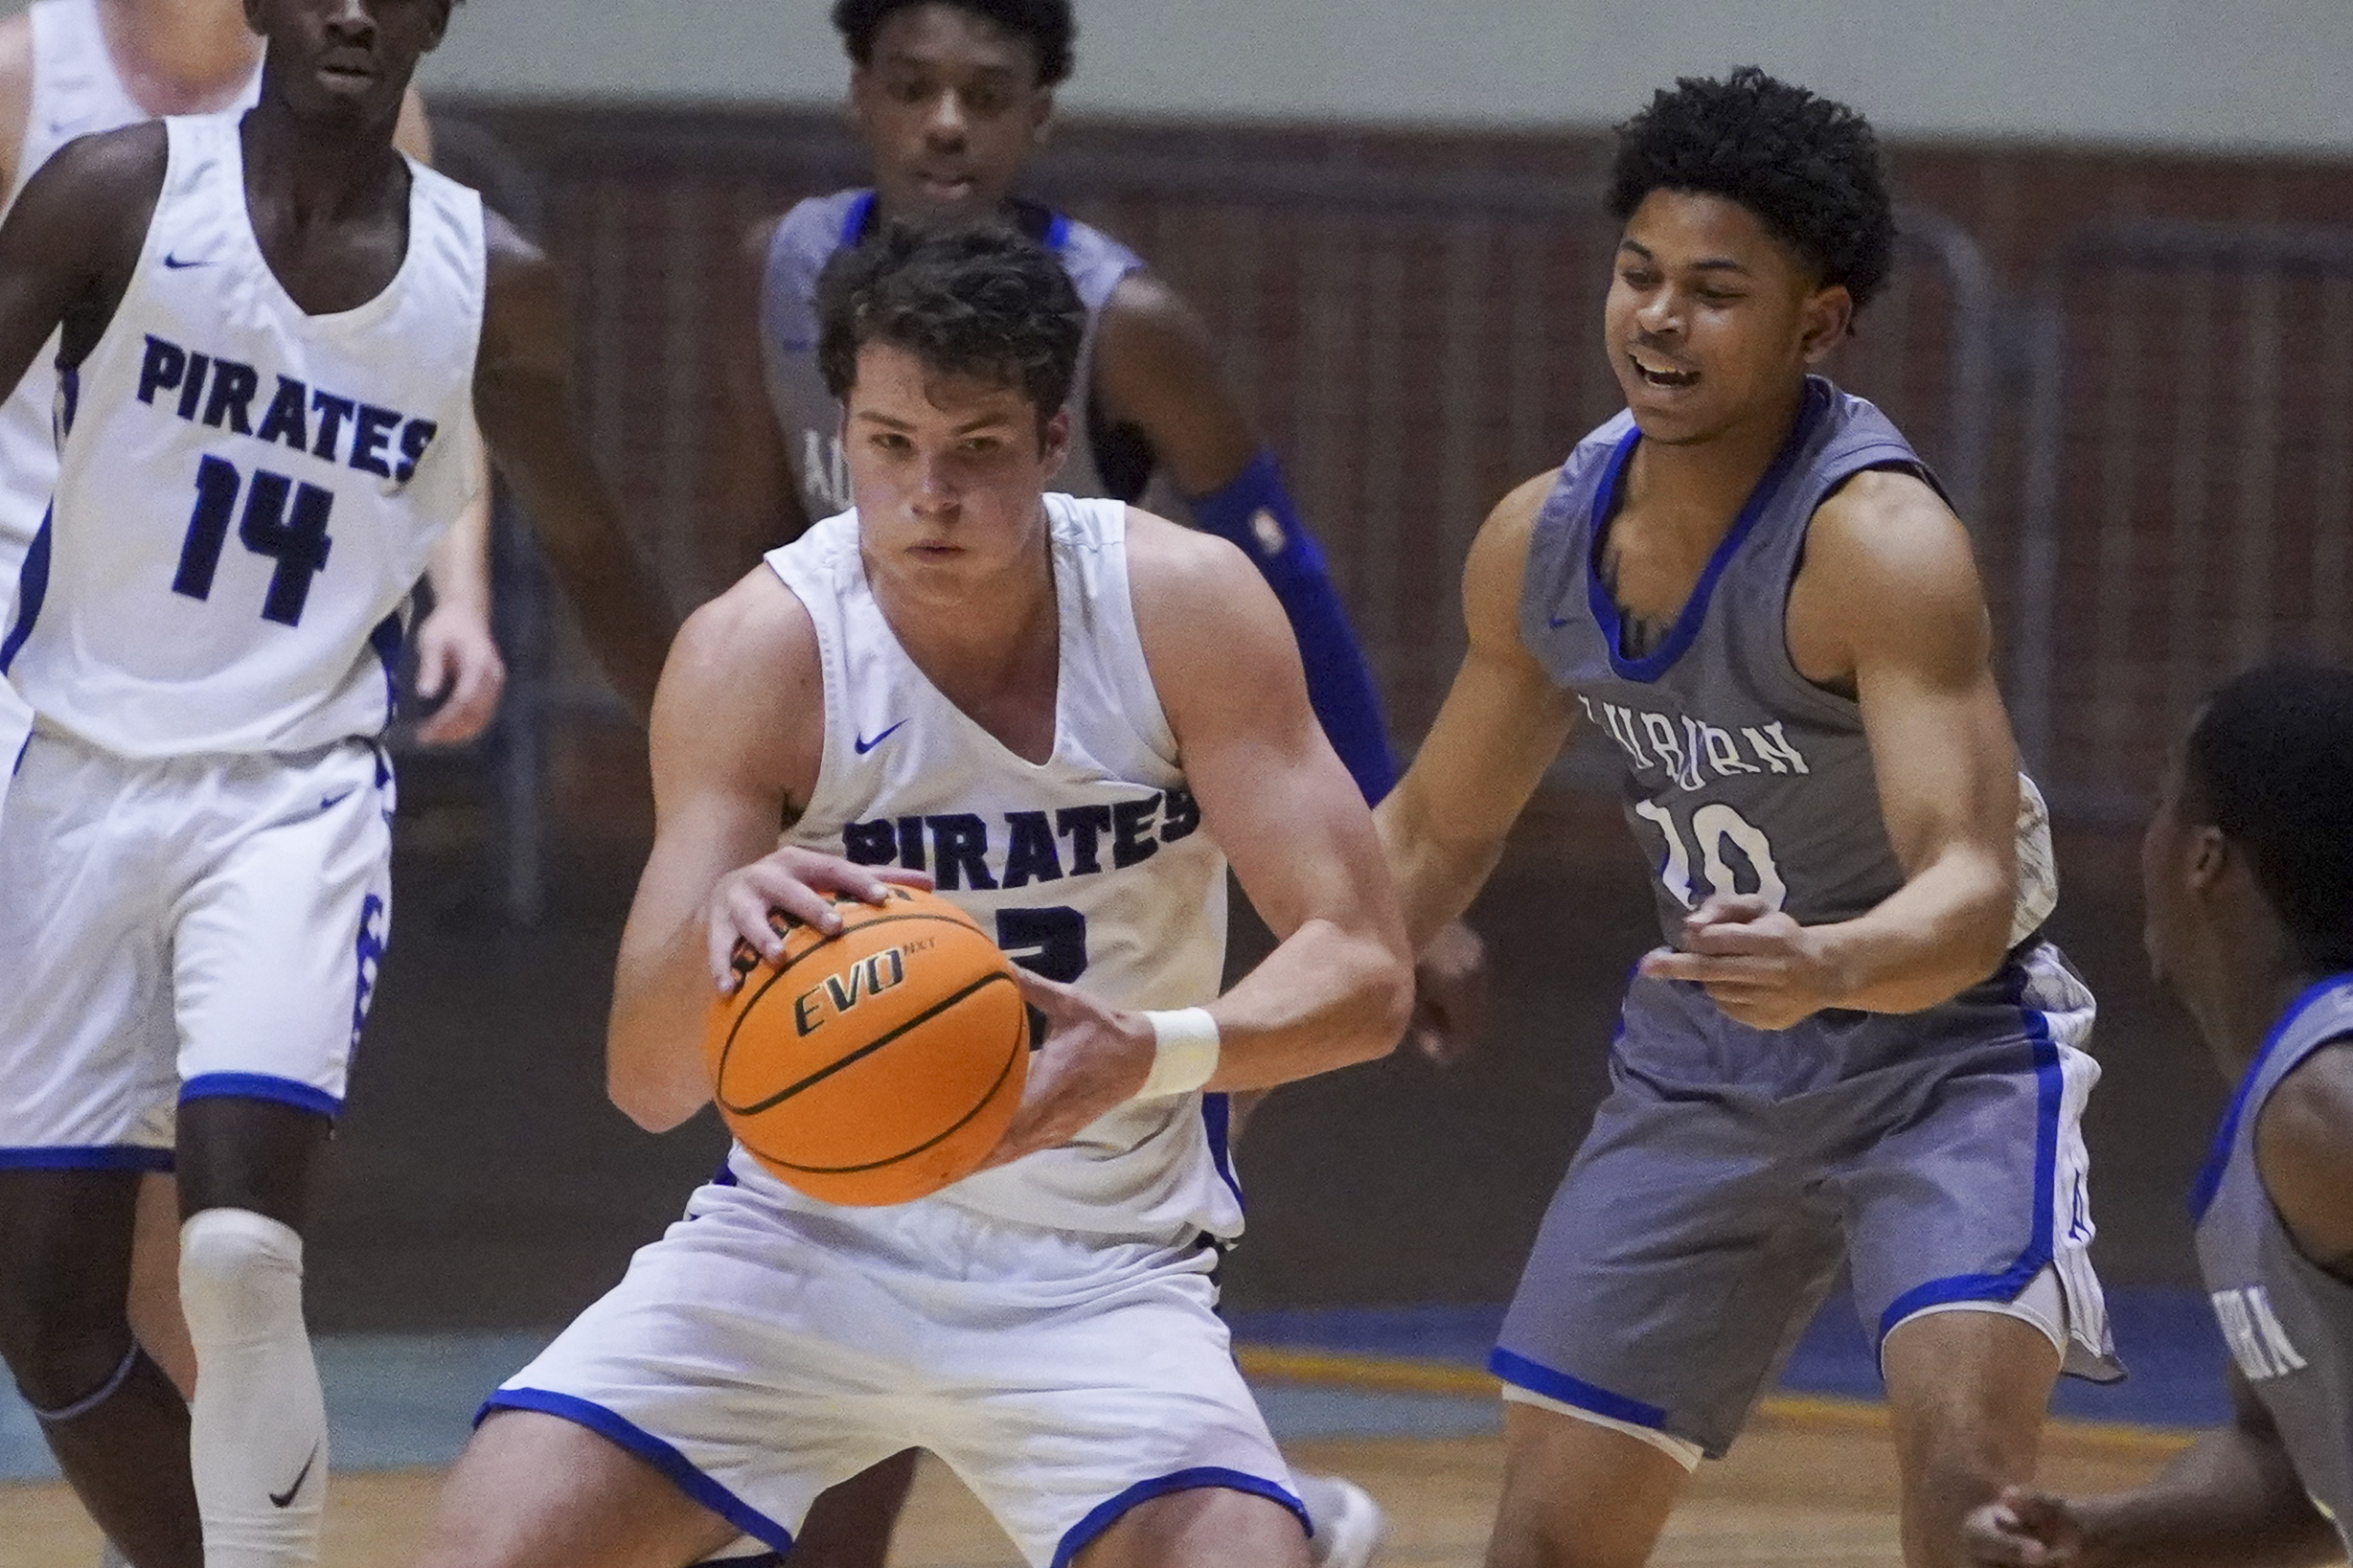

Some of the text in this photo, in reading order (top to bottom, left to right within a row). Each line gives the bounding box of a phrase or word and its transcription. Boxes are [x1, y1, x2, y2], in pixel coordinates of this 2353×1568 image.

[137, 332, 439, 485] PIRATES
[171, 453, 335, 628] 14
[842, 788, 1200, 891] PIRATES
[1635, 799, 1788, 912] 10
[793, 946, 904, 1037] EVO
